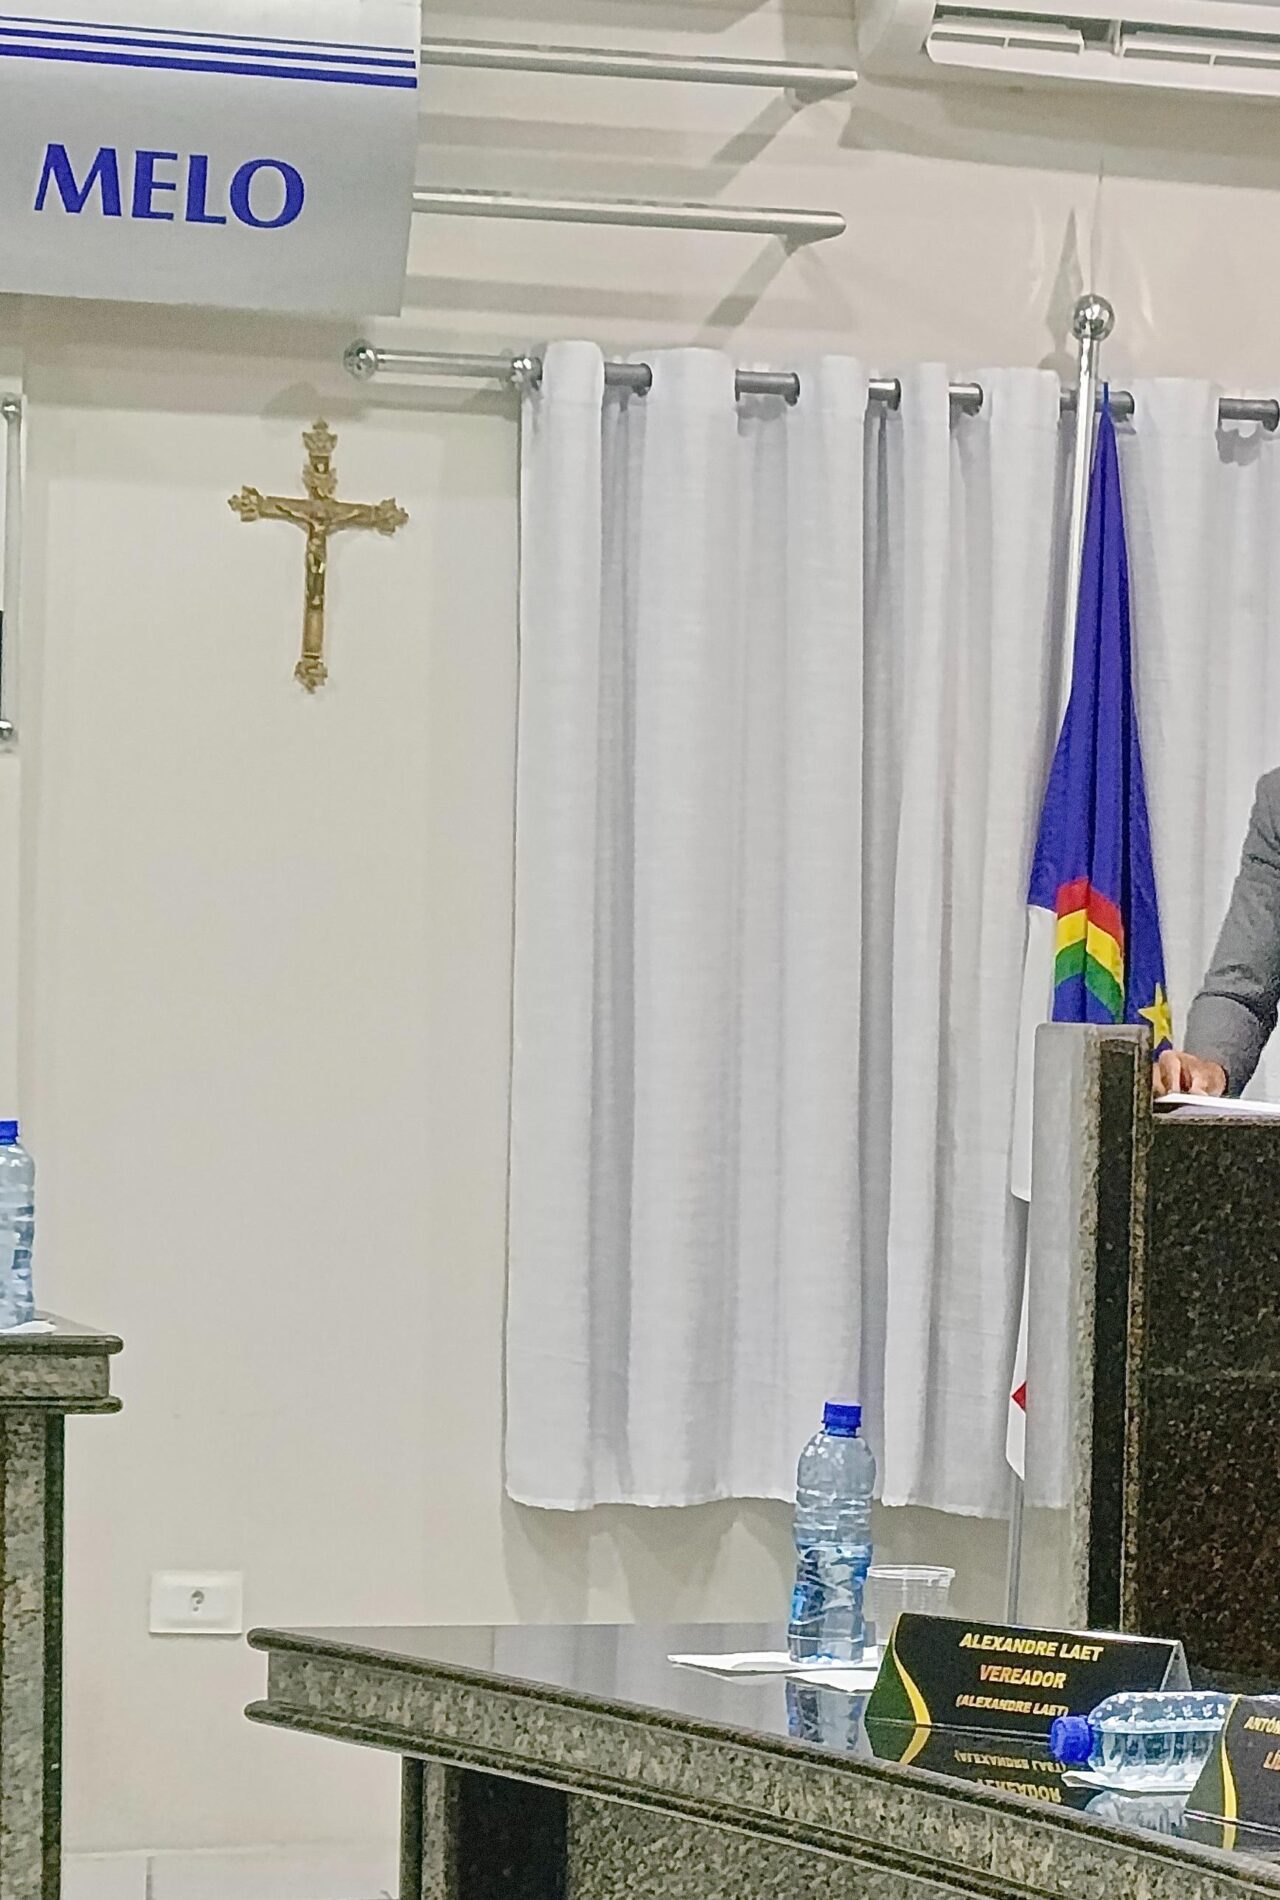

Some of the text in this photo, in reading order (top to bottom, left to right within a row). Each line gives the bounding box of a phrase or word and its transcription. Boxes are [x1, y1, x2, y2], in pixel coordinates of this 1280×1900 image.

[34, 143, 305, 229] MELO
[959, 1633, 1104, 1662] ALEXANDRE LAET
[980, 1664, 1067, 1689] VEREADOR
[955, 1694, 1069, 1718] (ALEXANDRE LAET)
